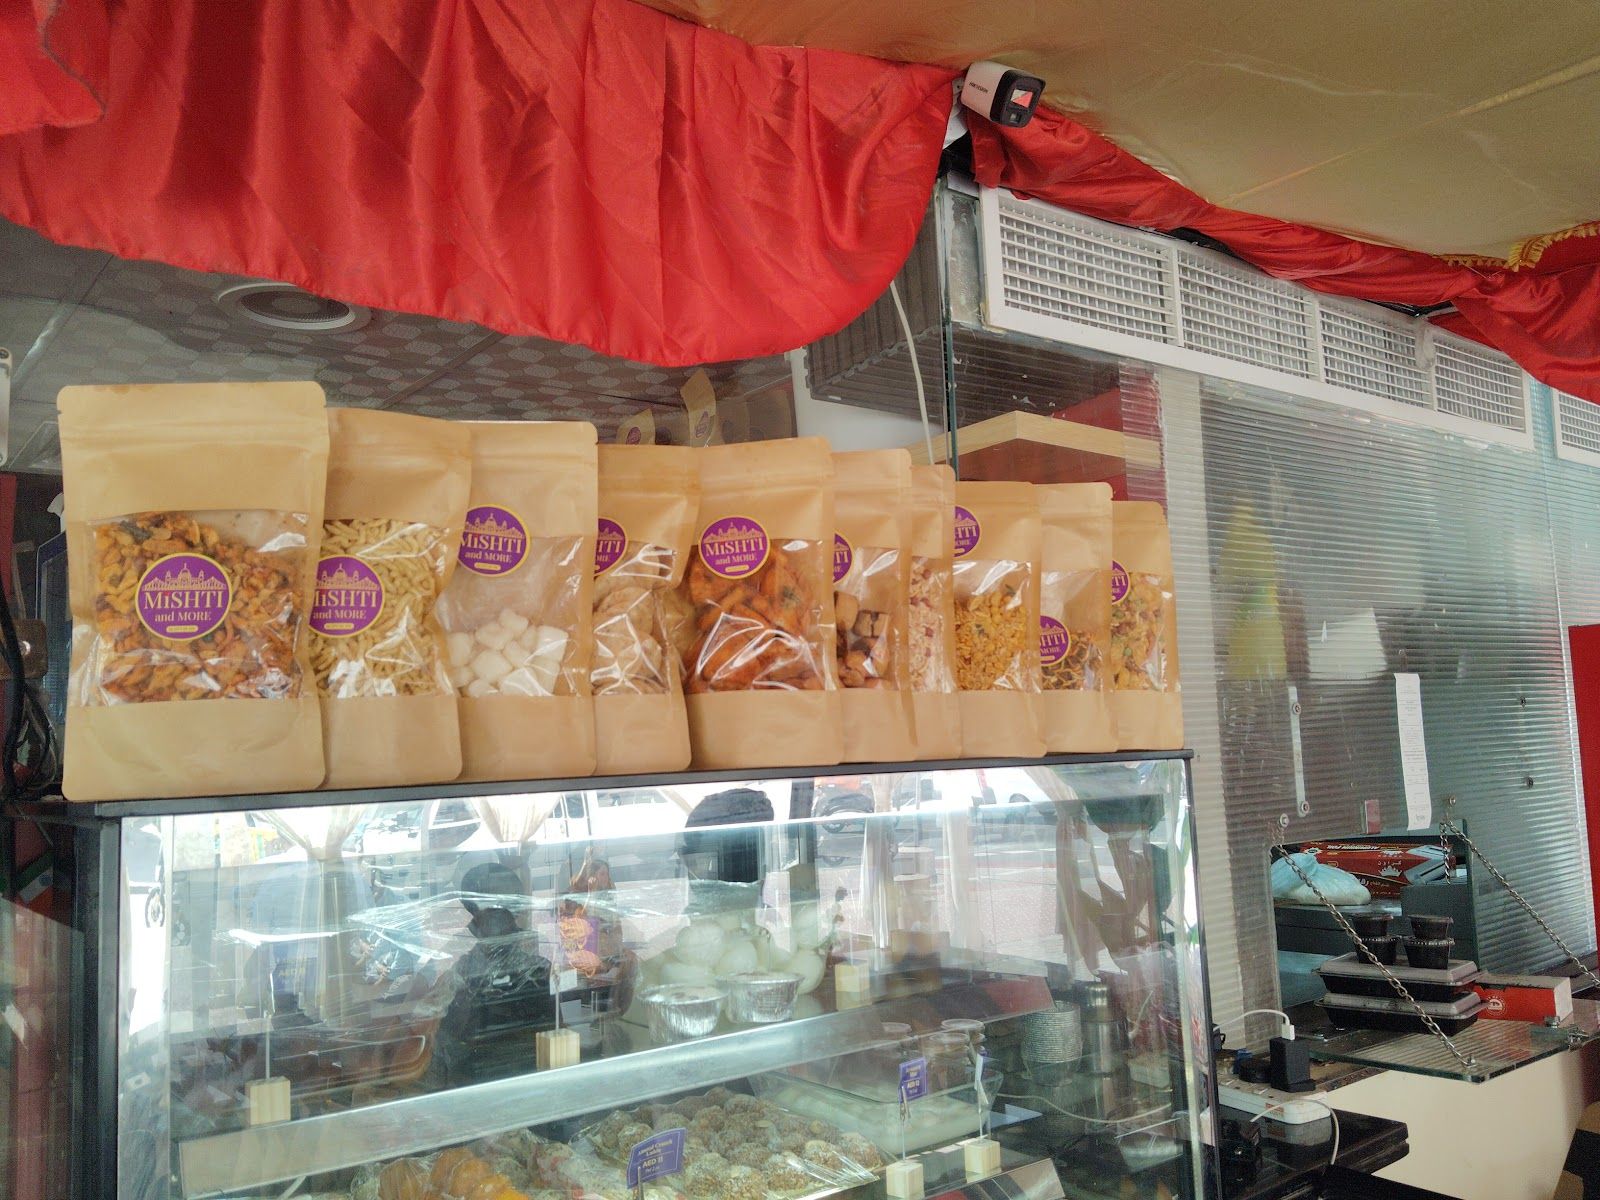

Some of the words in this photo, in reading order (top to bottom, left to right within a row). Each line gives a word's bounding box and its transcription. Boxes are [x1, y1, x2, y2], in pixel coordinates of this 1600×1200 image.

[464, 551, 482, 560] and
[484, 551, 512, 563] MORE
[715, 555, 731, 565] and
[154, 611, 175, 622] and
[177, 611, 212, 622] MORE
[313, 609, 332, 619] and
[334, 609, 366, 620] MORE
